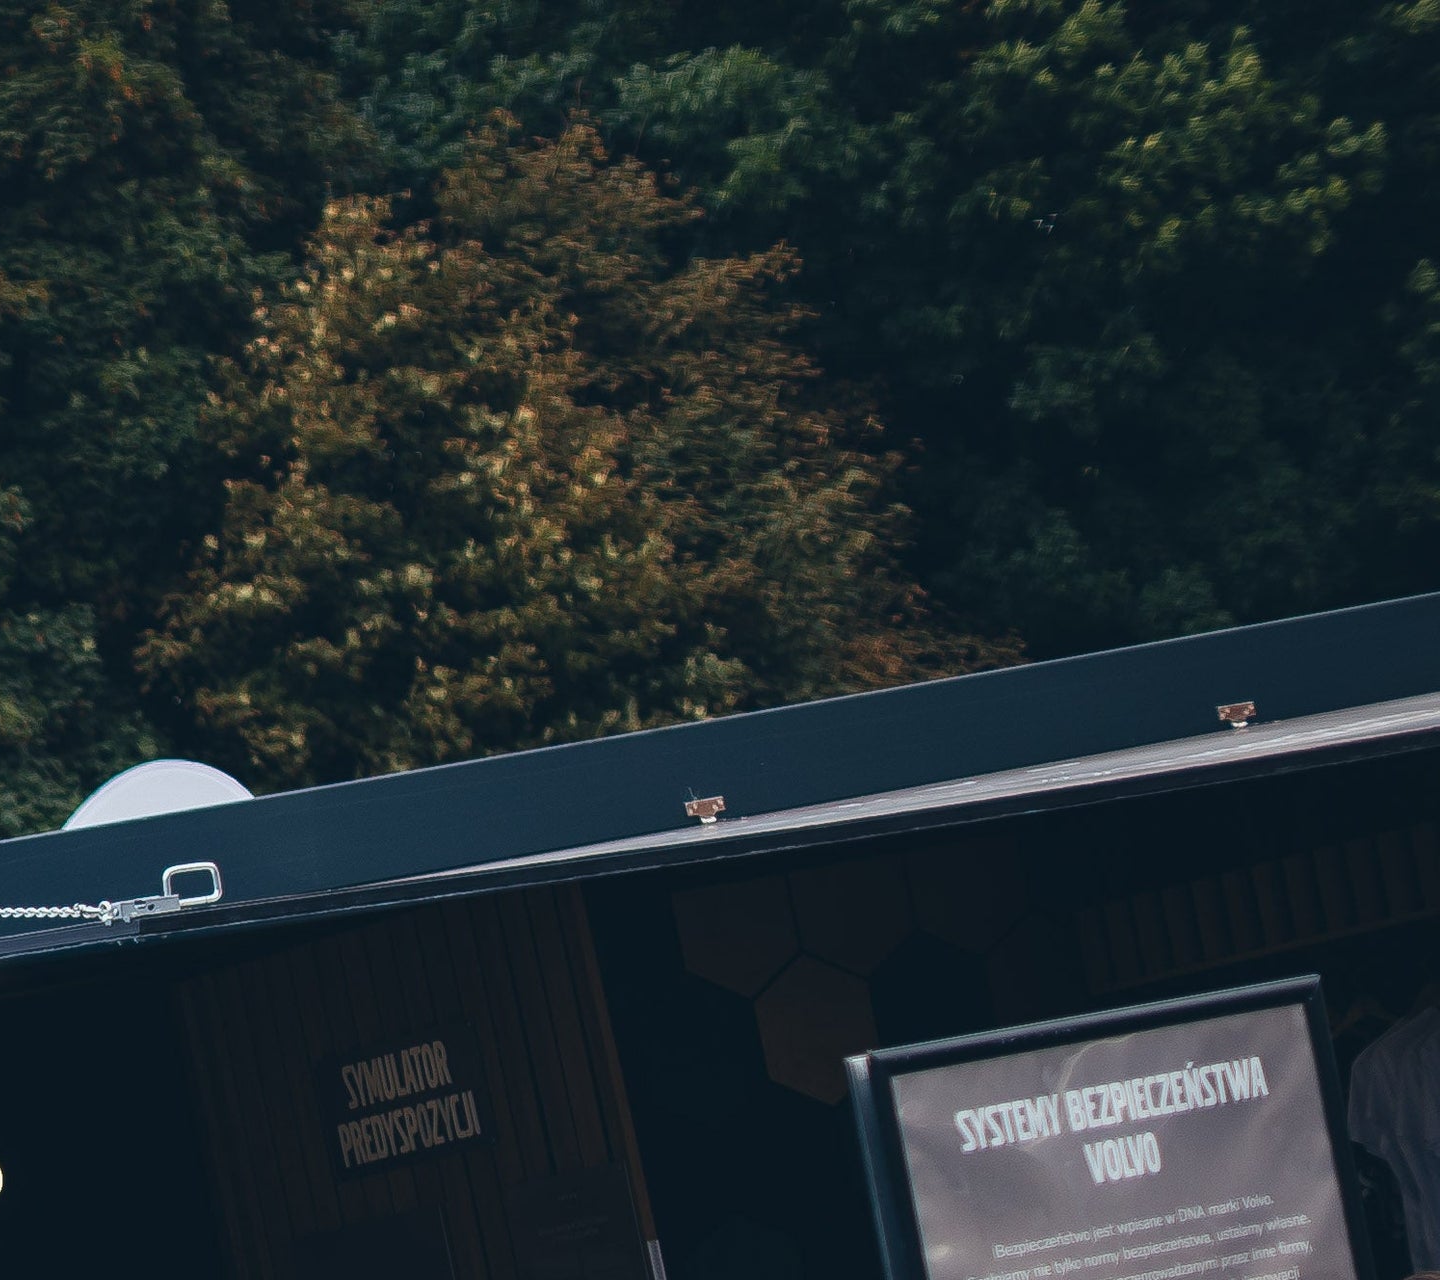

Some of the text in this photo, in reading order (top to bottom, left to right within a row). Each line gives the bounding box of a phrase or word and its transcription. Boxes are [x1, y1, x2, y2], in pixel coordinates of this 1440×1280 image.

[342, 1040, 453, 1110] SYMULATOR
[954, 1056, 1268, 1153] SYSTEMY BEZPIECZEŃSTWA
[337, 1090, 482, 1168] PREDYSPOZYCJI
[1083, 1131, 1162, 1185] VOLVO
[992, 1191, 1274, 1260] Bezpieczeństwo jest wpisane w DNA marki Volvo.
